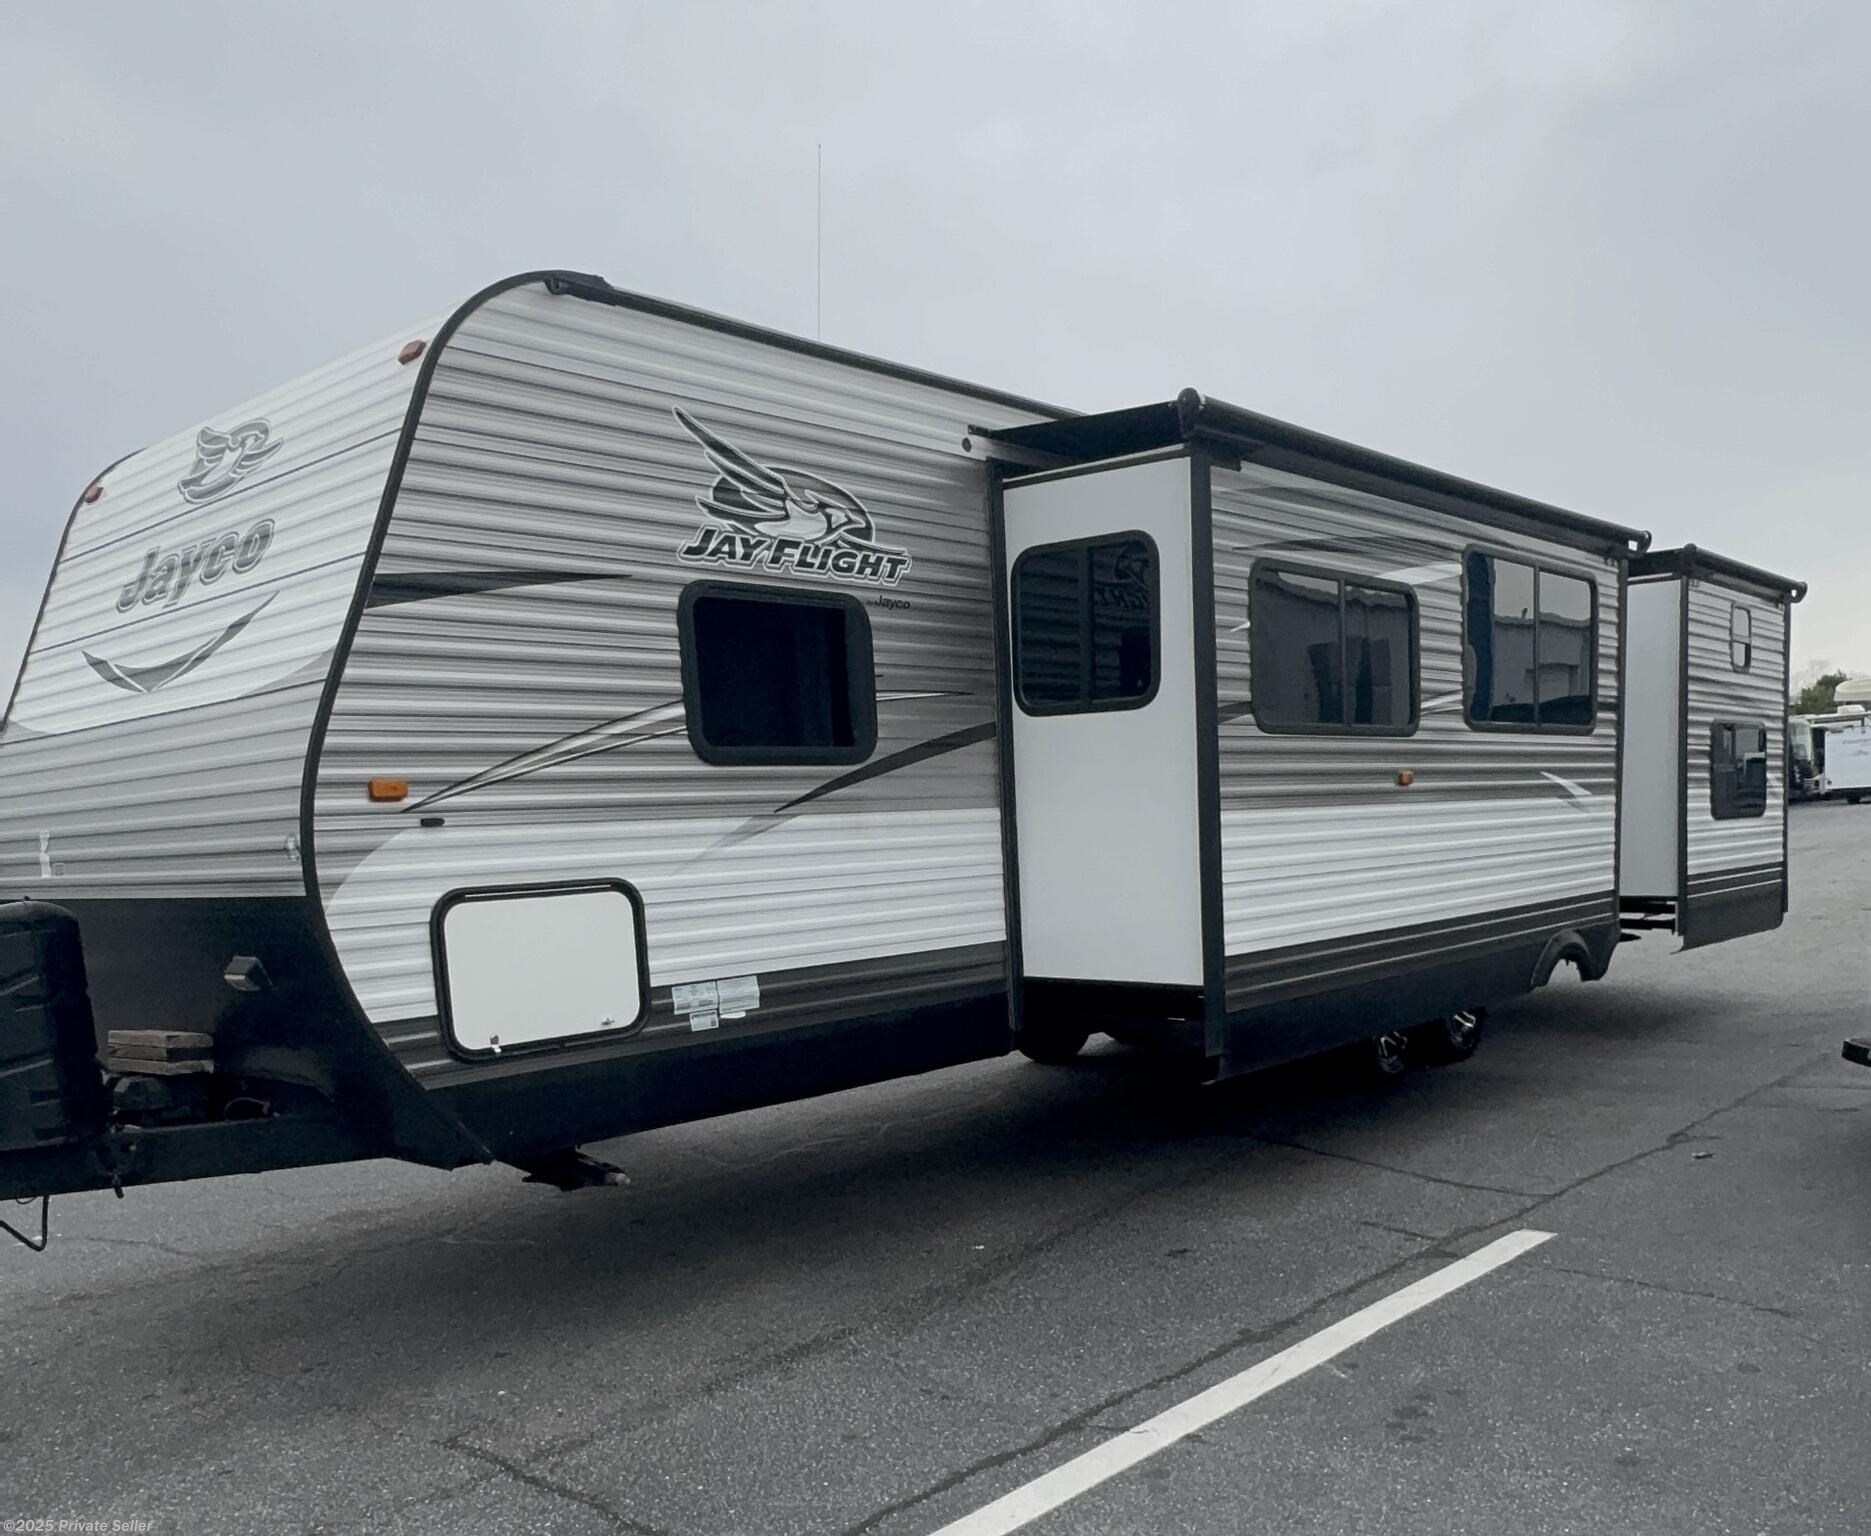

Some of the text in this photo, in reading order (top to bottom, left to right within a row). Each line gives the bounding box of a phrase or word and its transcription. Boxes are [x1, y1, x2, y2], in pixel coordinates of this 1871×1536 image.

[116, 518, 275, 613] Jayco
[680, 526, 911, 583] JAY FLIGHT
[874, 595, 911, 611] Jayco
